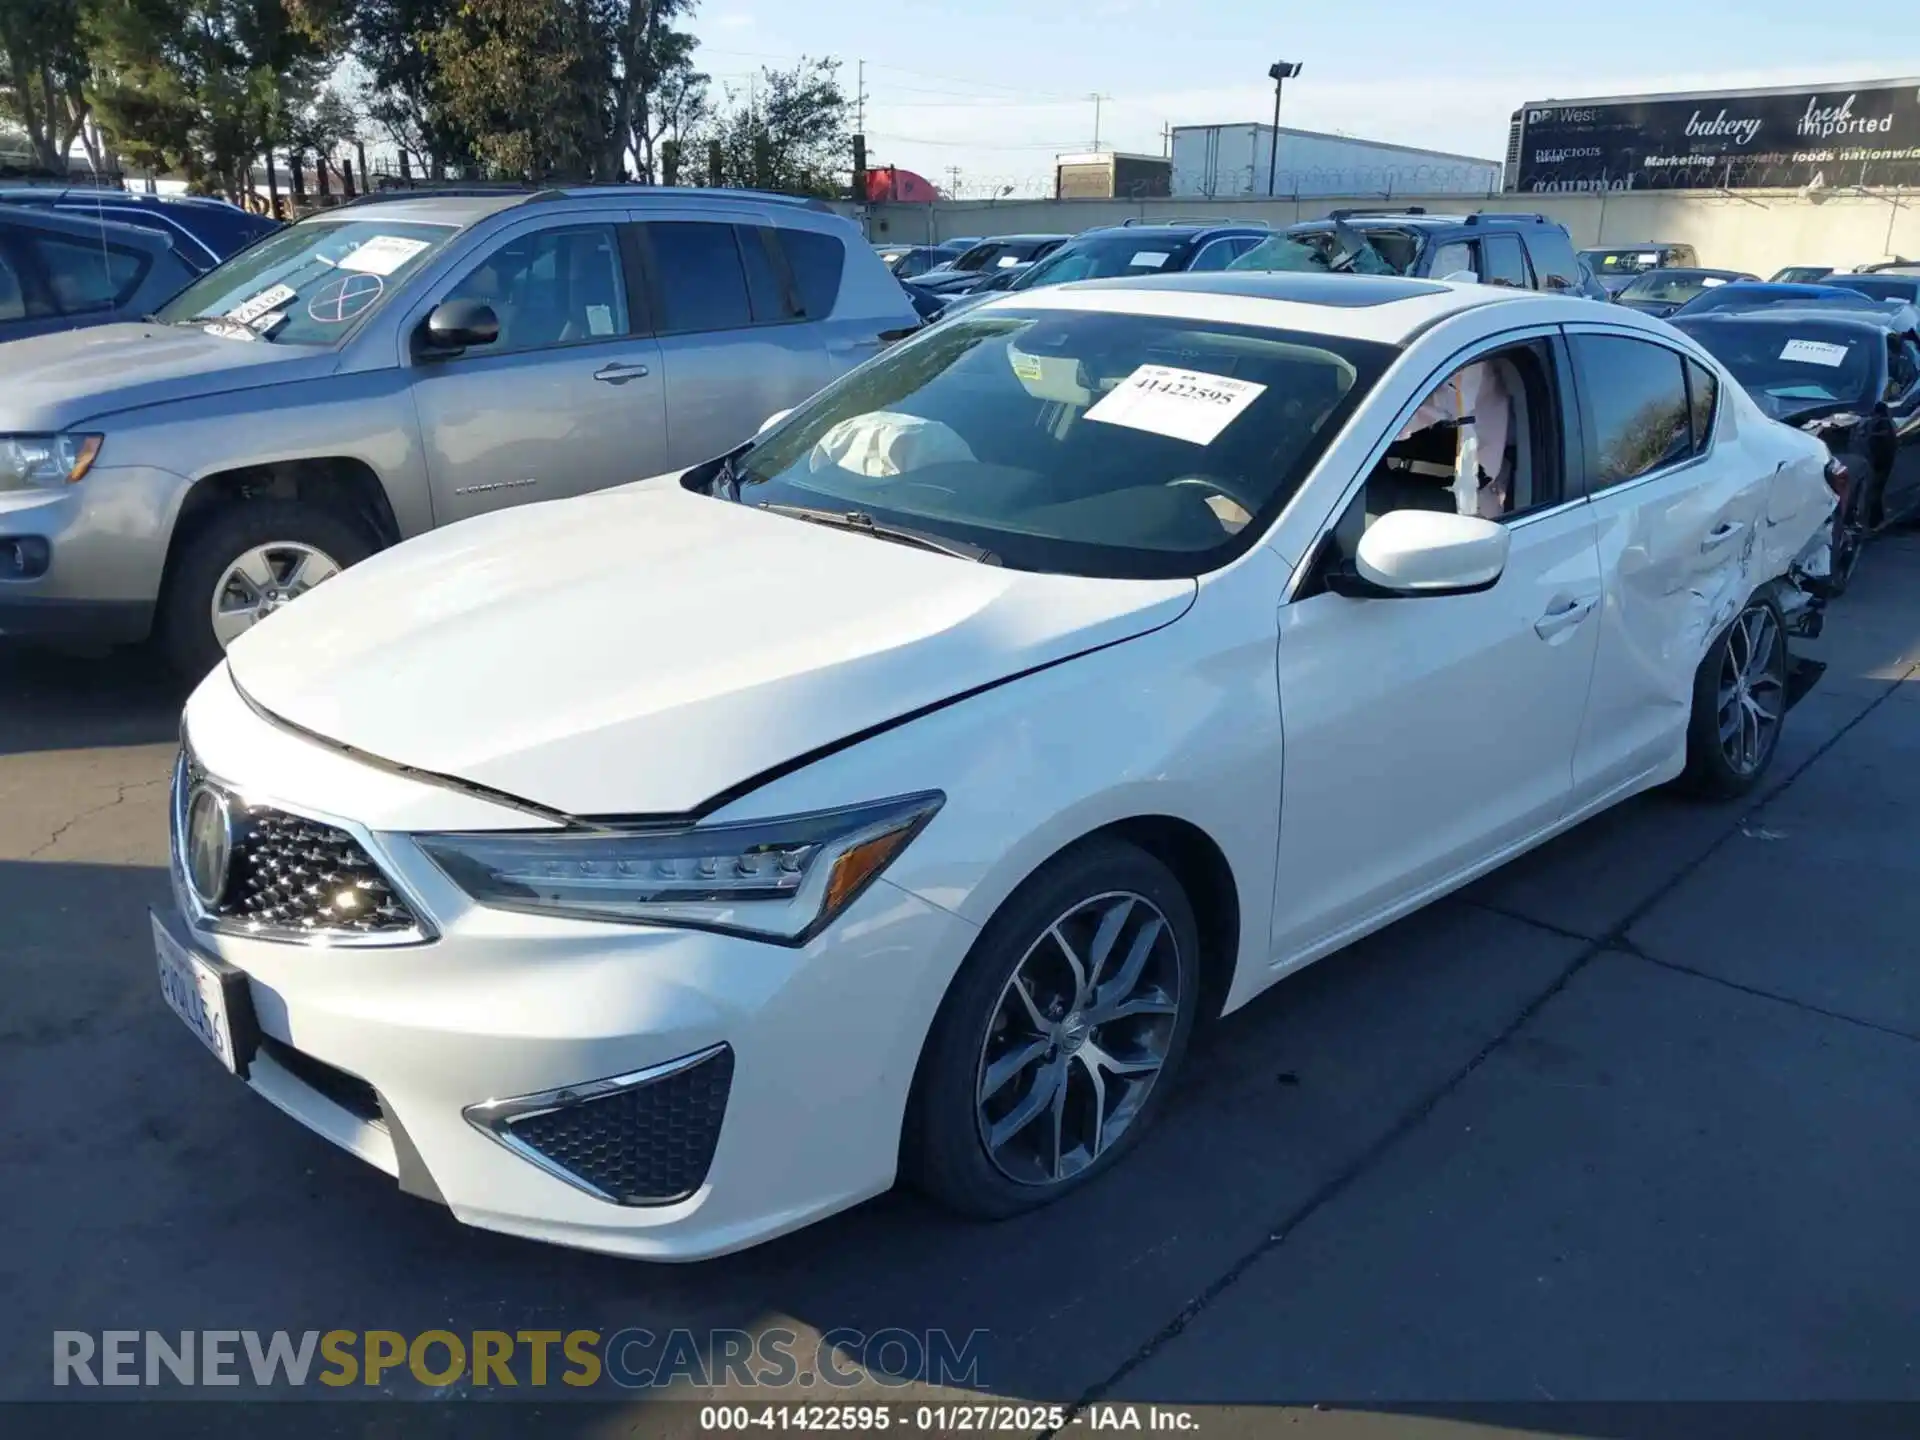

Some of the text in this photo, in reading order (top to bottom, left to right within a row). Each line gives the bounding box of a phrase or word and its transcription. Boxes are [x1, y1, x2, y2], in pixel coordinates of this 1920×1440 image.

[1685, 108, 1761, 145] bakery
[1796, 113, 1893, 139] imported
[1644, 154, 1716, 167] Marketing
[1792, 151, 1835, 162] foods
[1134, 378, 1236, 406] 41422595
